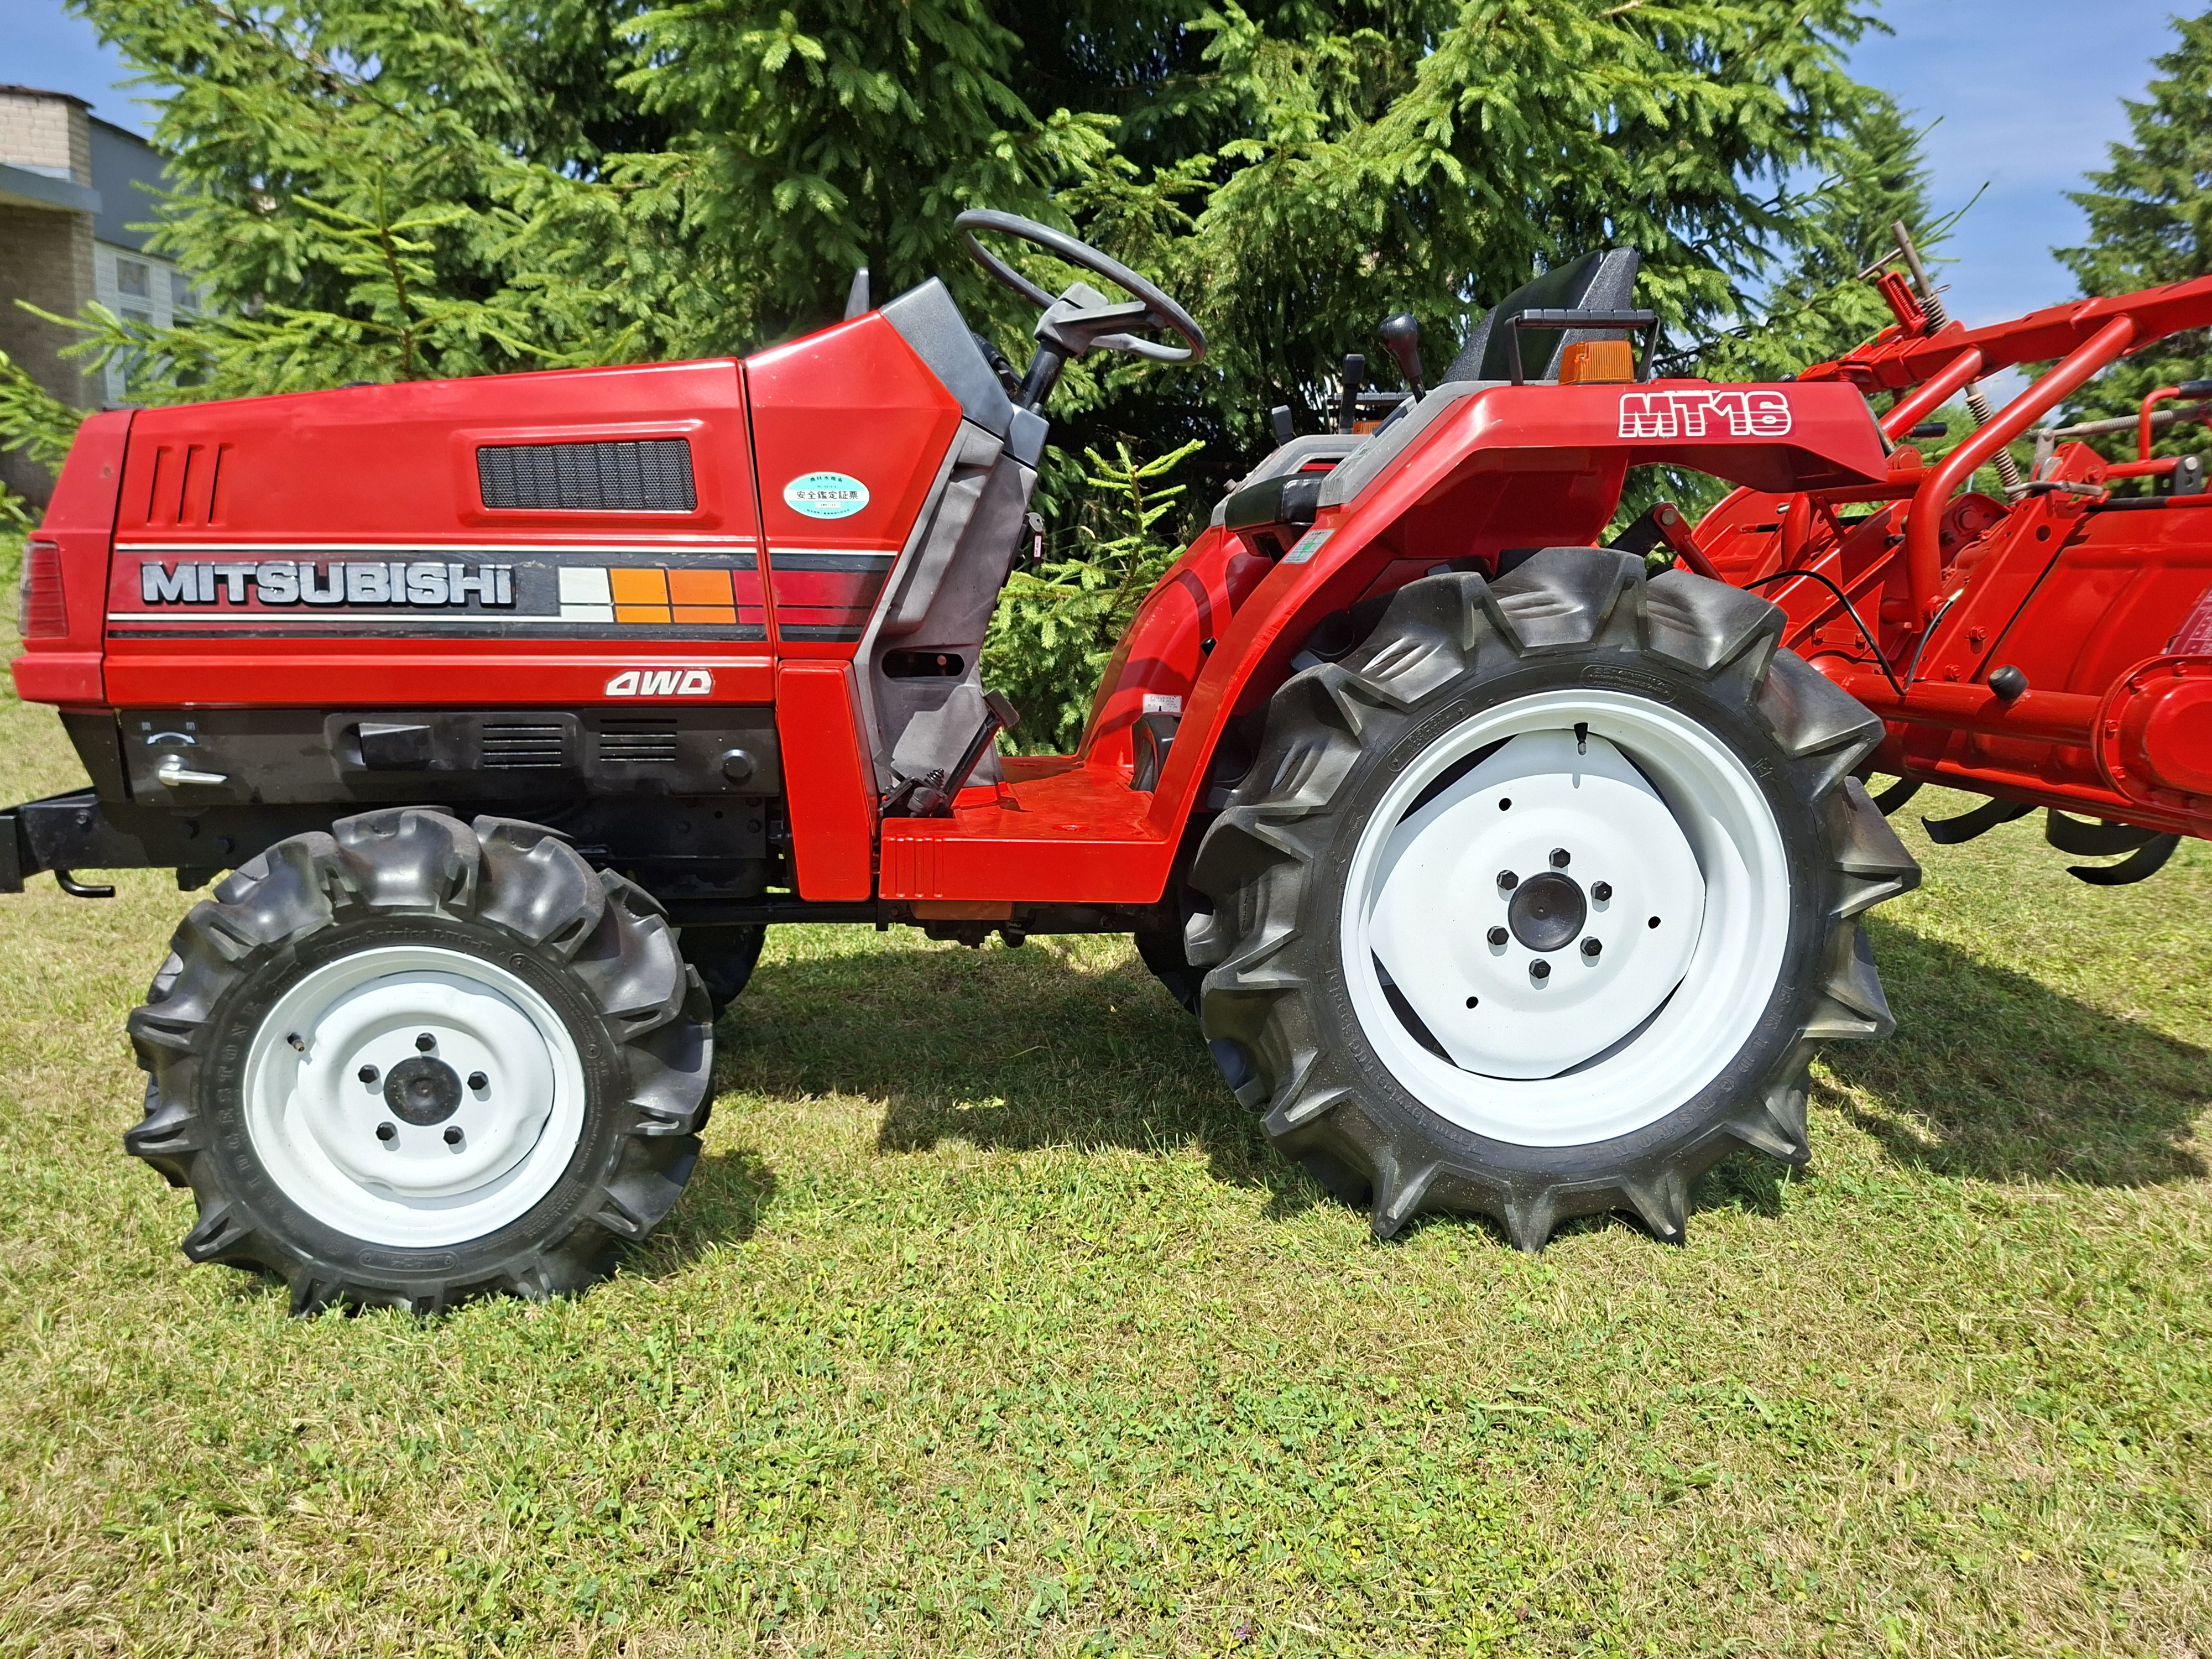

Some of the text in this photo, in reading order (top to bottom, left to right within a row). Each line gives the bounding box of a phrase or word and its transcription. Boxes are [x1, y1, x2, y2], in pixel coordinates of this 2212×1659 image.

[1618, 391, 1792, 437] MT16
[142, 561, 515, 607] MITSUBISHI
[1584, 983, 1796, 1161] BRIDGESTONE
[217, 999, 300, 1234] BRIDGESTONE
[1376, 1076, 1431, 1130] Service
